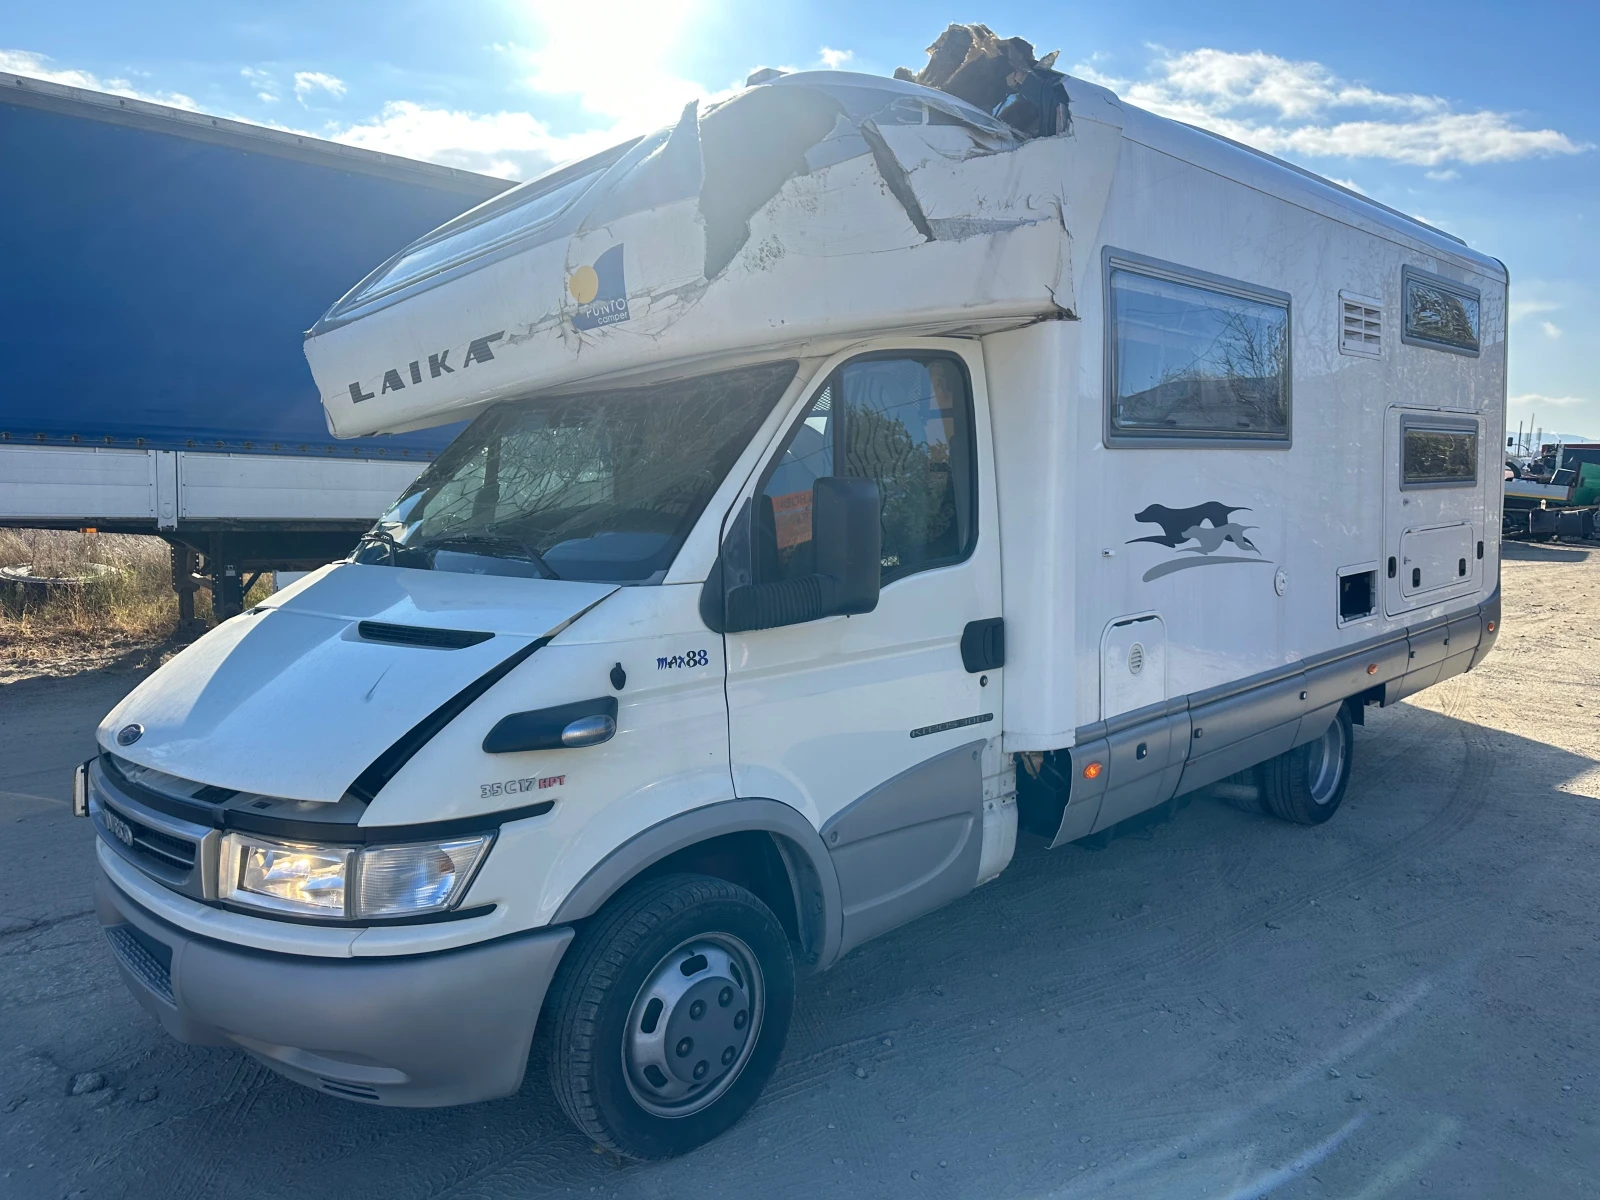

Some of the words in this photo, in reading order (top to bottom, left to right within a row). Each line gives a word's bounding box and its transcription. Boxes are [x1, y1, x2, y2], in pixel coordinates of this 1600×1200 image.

[597, 311, 628, 325] camper
[348, 330, 505, 404] LAIKA
[538, 774, 566, 789] HPT
